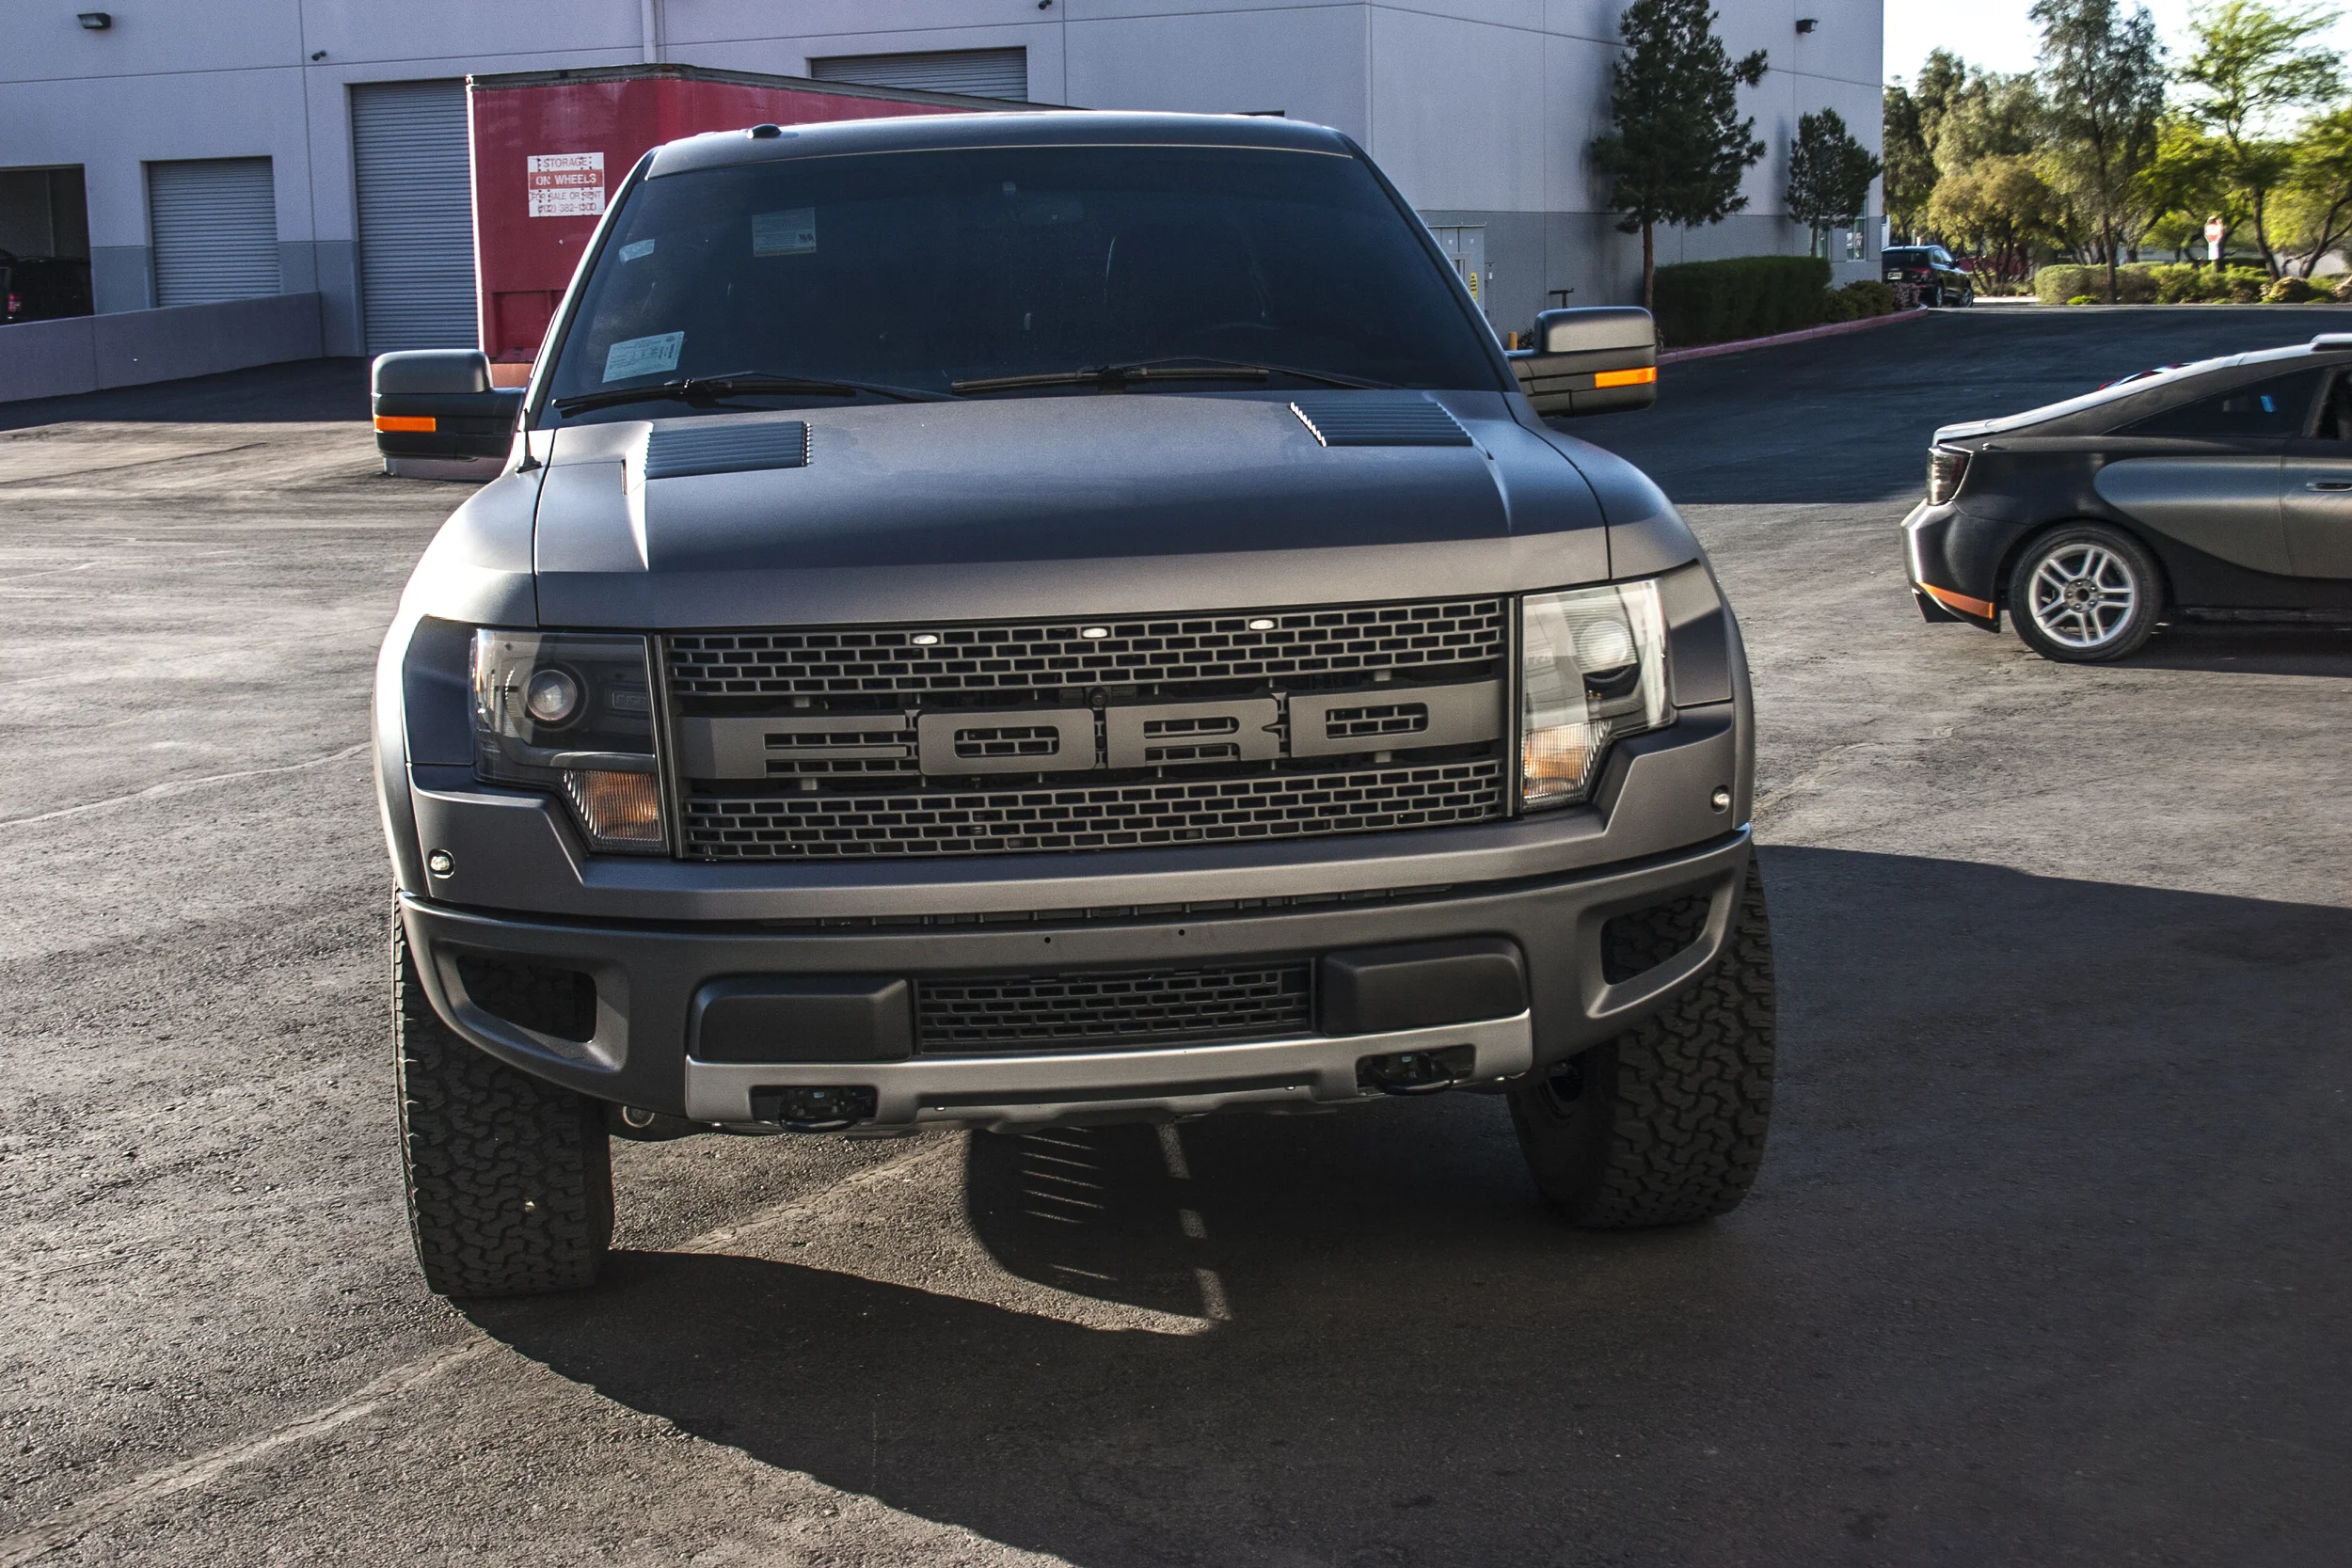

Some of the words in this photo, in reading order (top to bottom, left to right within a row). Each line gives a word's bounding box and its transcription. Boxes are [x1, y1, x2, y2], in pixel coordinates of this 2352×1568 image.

[543, 156, 588, 168] STORAGE
[535, 175, 551, 186] ON
[554, 172, 597, 185] WHEELS
[549, 191, 567, 200] SALE
[569, 191, 580, 200] OR
[681, 679, 1503, 779] FORD
